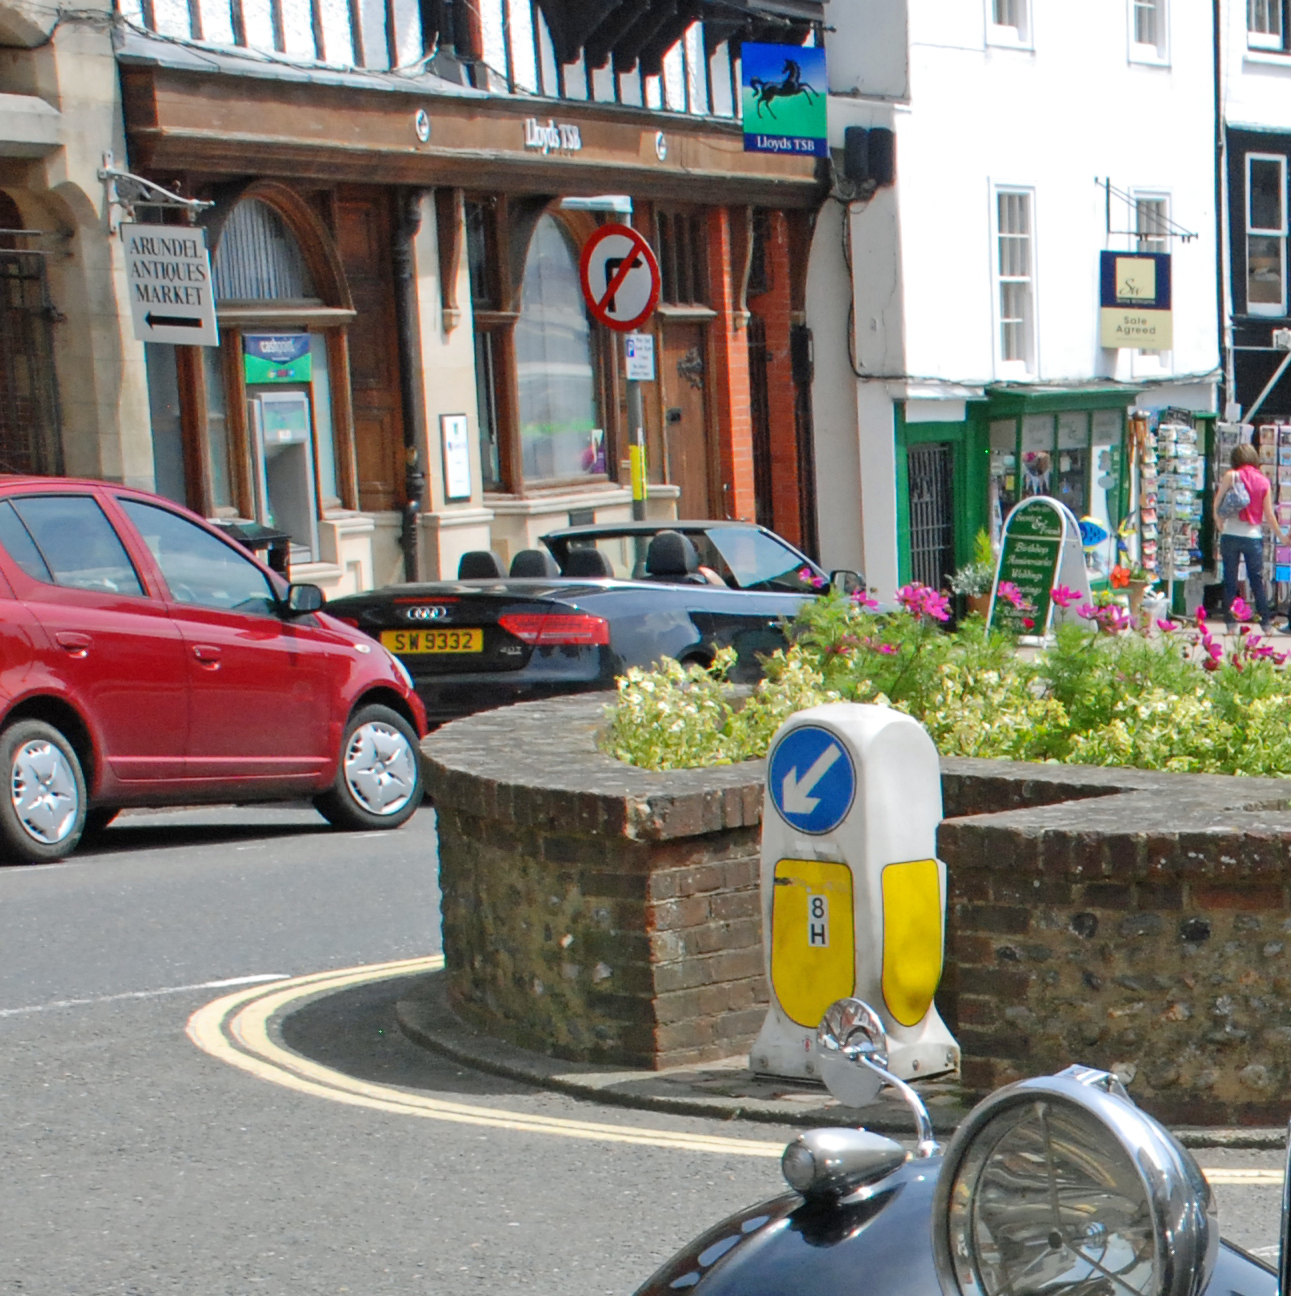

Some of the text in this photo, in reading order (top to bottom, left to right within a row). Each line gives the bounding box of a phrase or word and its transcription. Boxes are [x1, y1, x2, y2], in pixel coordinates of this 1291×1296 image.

[526, 118, 581, 155] Lloyds TSB
[757, 136, 815, 151] Lloyds TSB
[130, 236, 203, 259] ARUNDEL
[131, 260, 206, 282] ANTIQUES
[135, 284, 203, 306] MARKET
[1116, 325, 1157, 336] Agreed
[1124, 316, 1148, 326] Sale
[395, 632, 473, 651] SW 9332
[812, 897, 825, 919] 8
[811, 923, 826, 945] H
